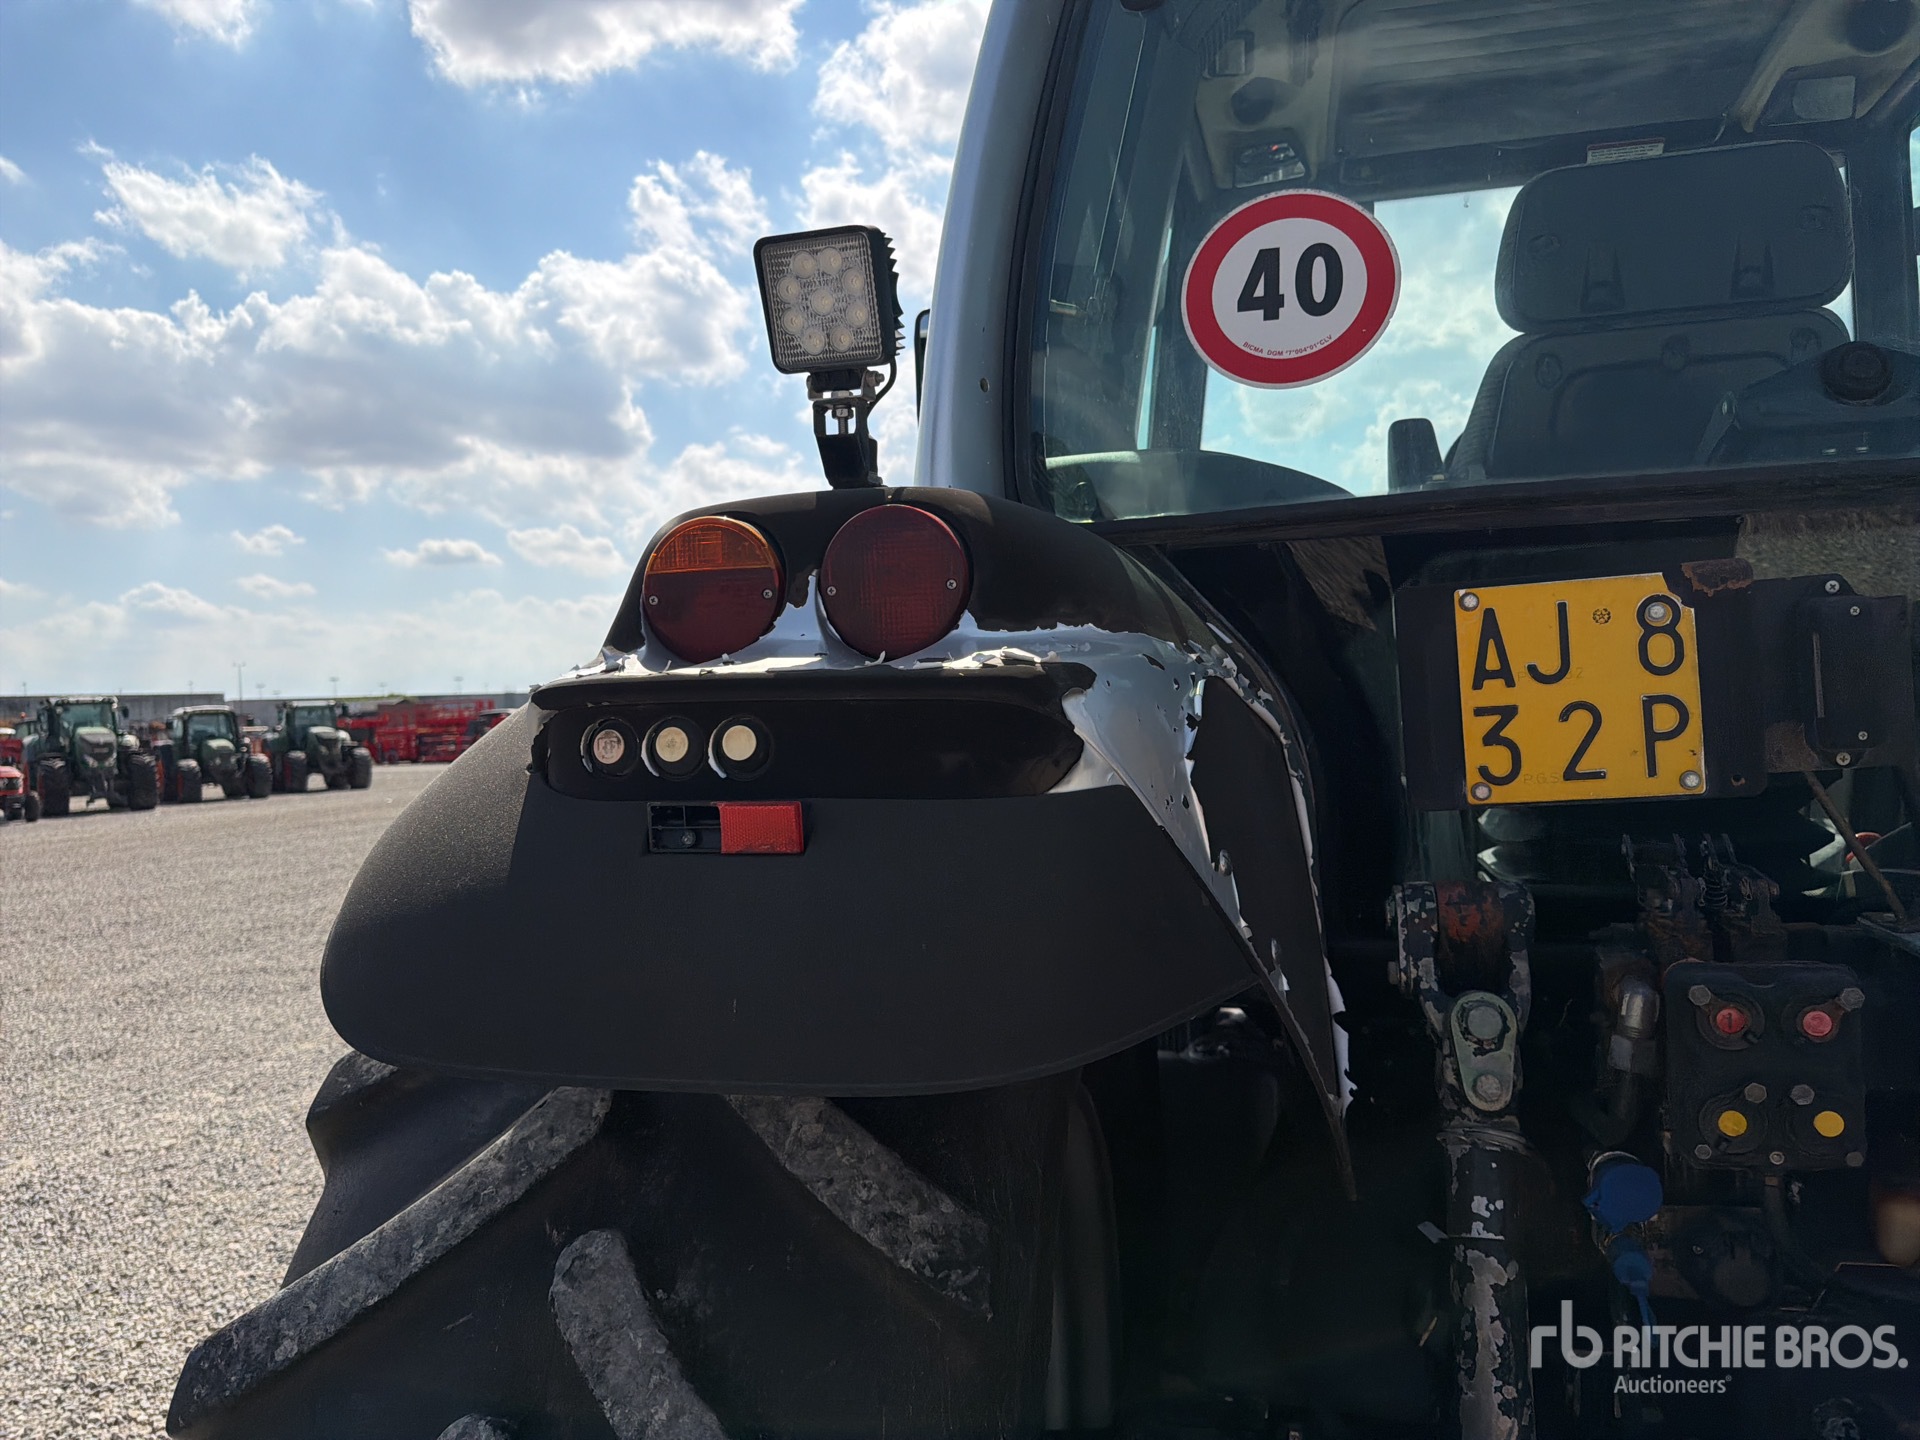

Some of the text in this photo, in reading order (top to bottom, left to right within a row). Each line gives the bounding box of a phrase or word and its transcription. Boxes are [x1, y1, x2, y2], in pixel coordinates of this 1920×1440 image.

[1237, 242, 1344, 321] 40
[1242, 341, 1264, 354] BICMA
[1472, 594, 1684, 690] AJ 8
